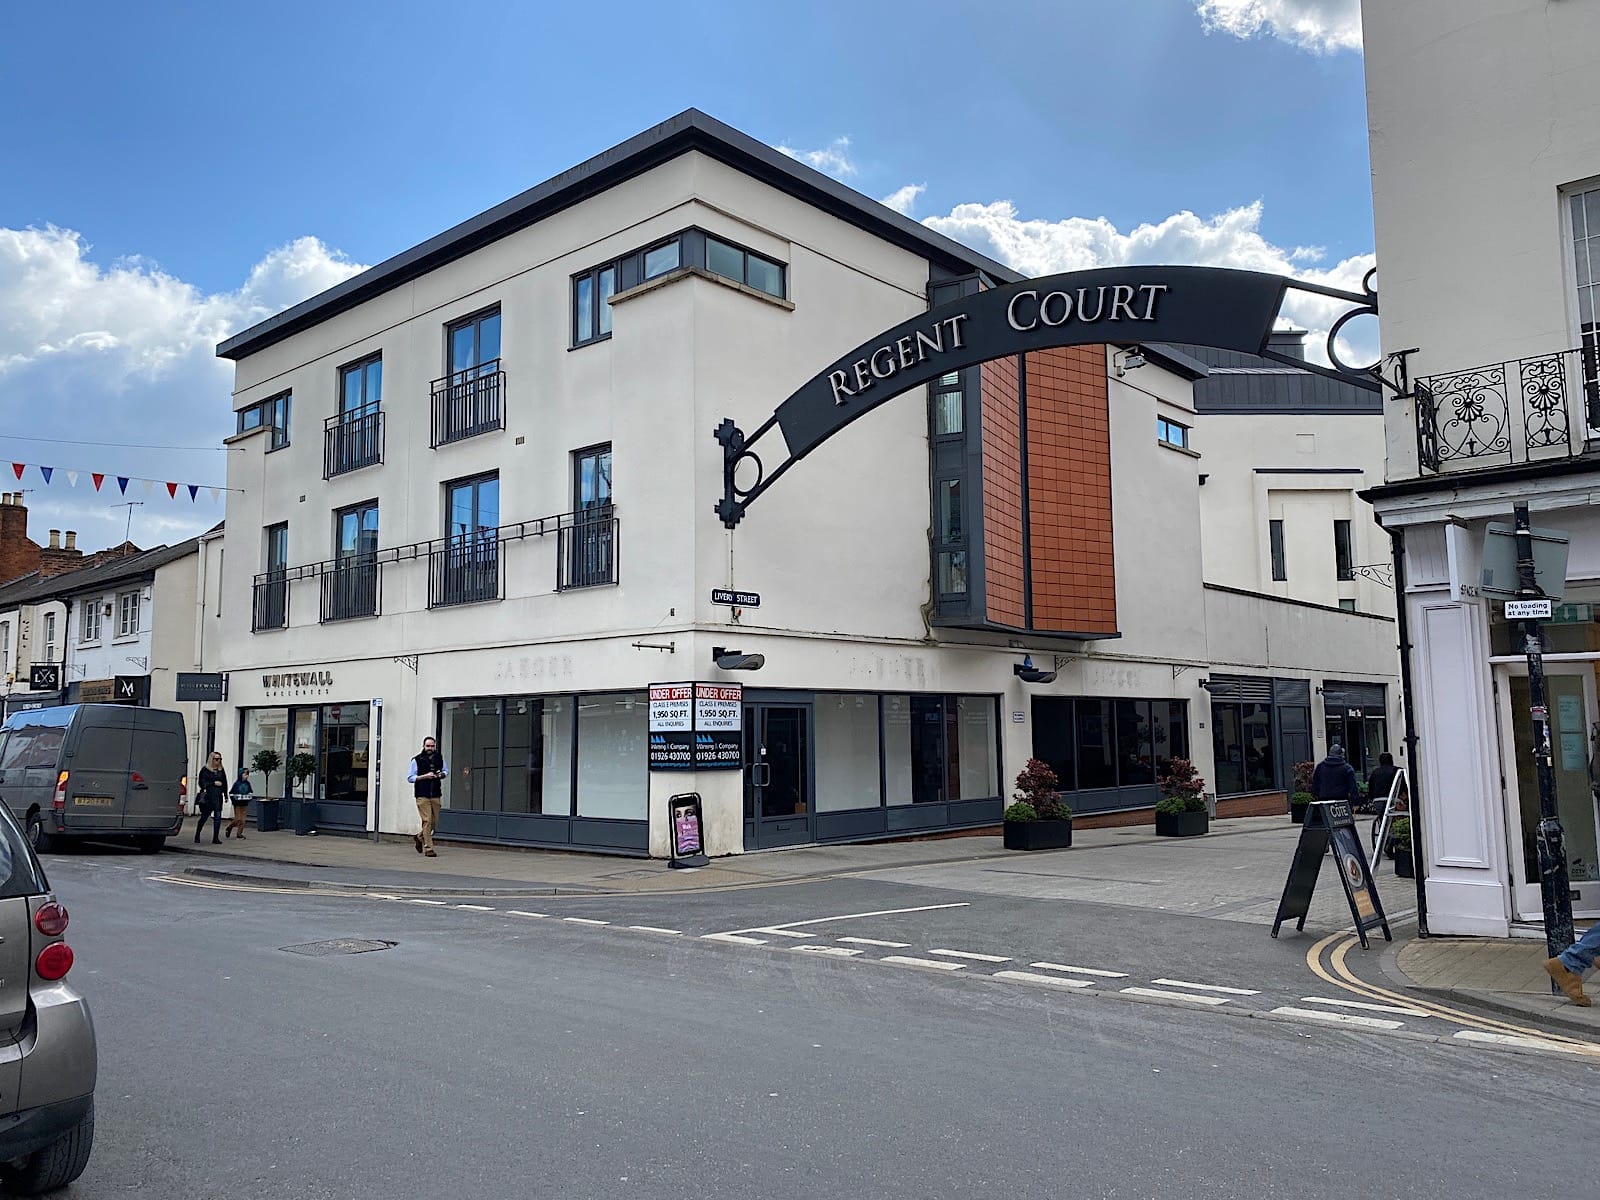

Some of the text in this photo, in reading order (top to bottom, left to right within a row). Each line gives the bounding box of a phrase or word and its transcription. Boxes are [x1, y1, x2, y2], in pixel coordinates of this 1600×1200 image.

[828, 283, 1167, 406] REGENT COURT
[714, 592, 758, 604] LIVERY STREET
[262, 671, 333, 688] WHITEWALL
[650, 688, 692, 700] UNDER OFFER
[695, 687, 742, 700] UNDER OFFER
[653, 710, 668, 719] 1,950
[699, 709, 716, 718] 1,950
[718, 742, 738, 750] Company
[650, 752, 691, 760] 01926 430700
[696, 751, 740, 760] 01926 430700
